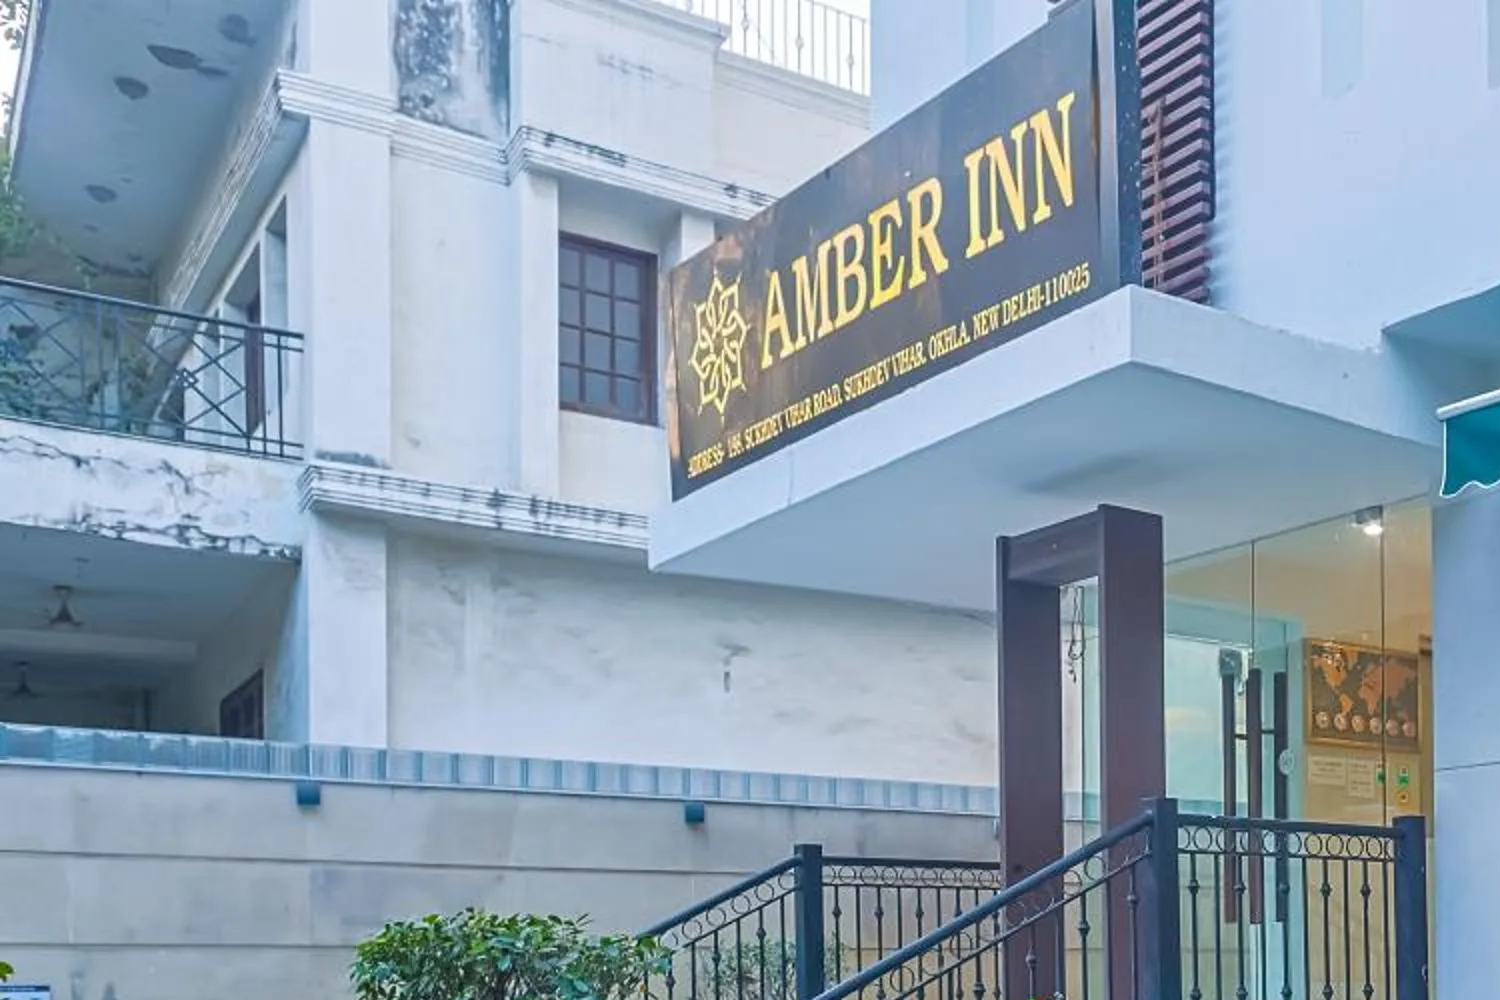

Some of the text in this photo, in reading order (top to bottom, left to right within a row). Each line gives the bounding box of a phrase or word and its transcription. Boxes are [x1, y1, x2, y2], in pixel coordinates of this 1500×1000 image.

[761, 91, 1076, 369] AMBER INN
[843, 357, 890, 401] SUKHDEV
[972, 303, 1001, 340] NEW
